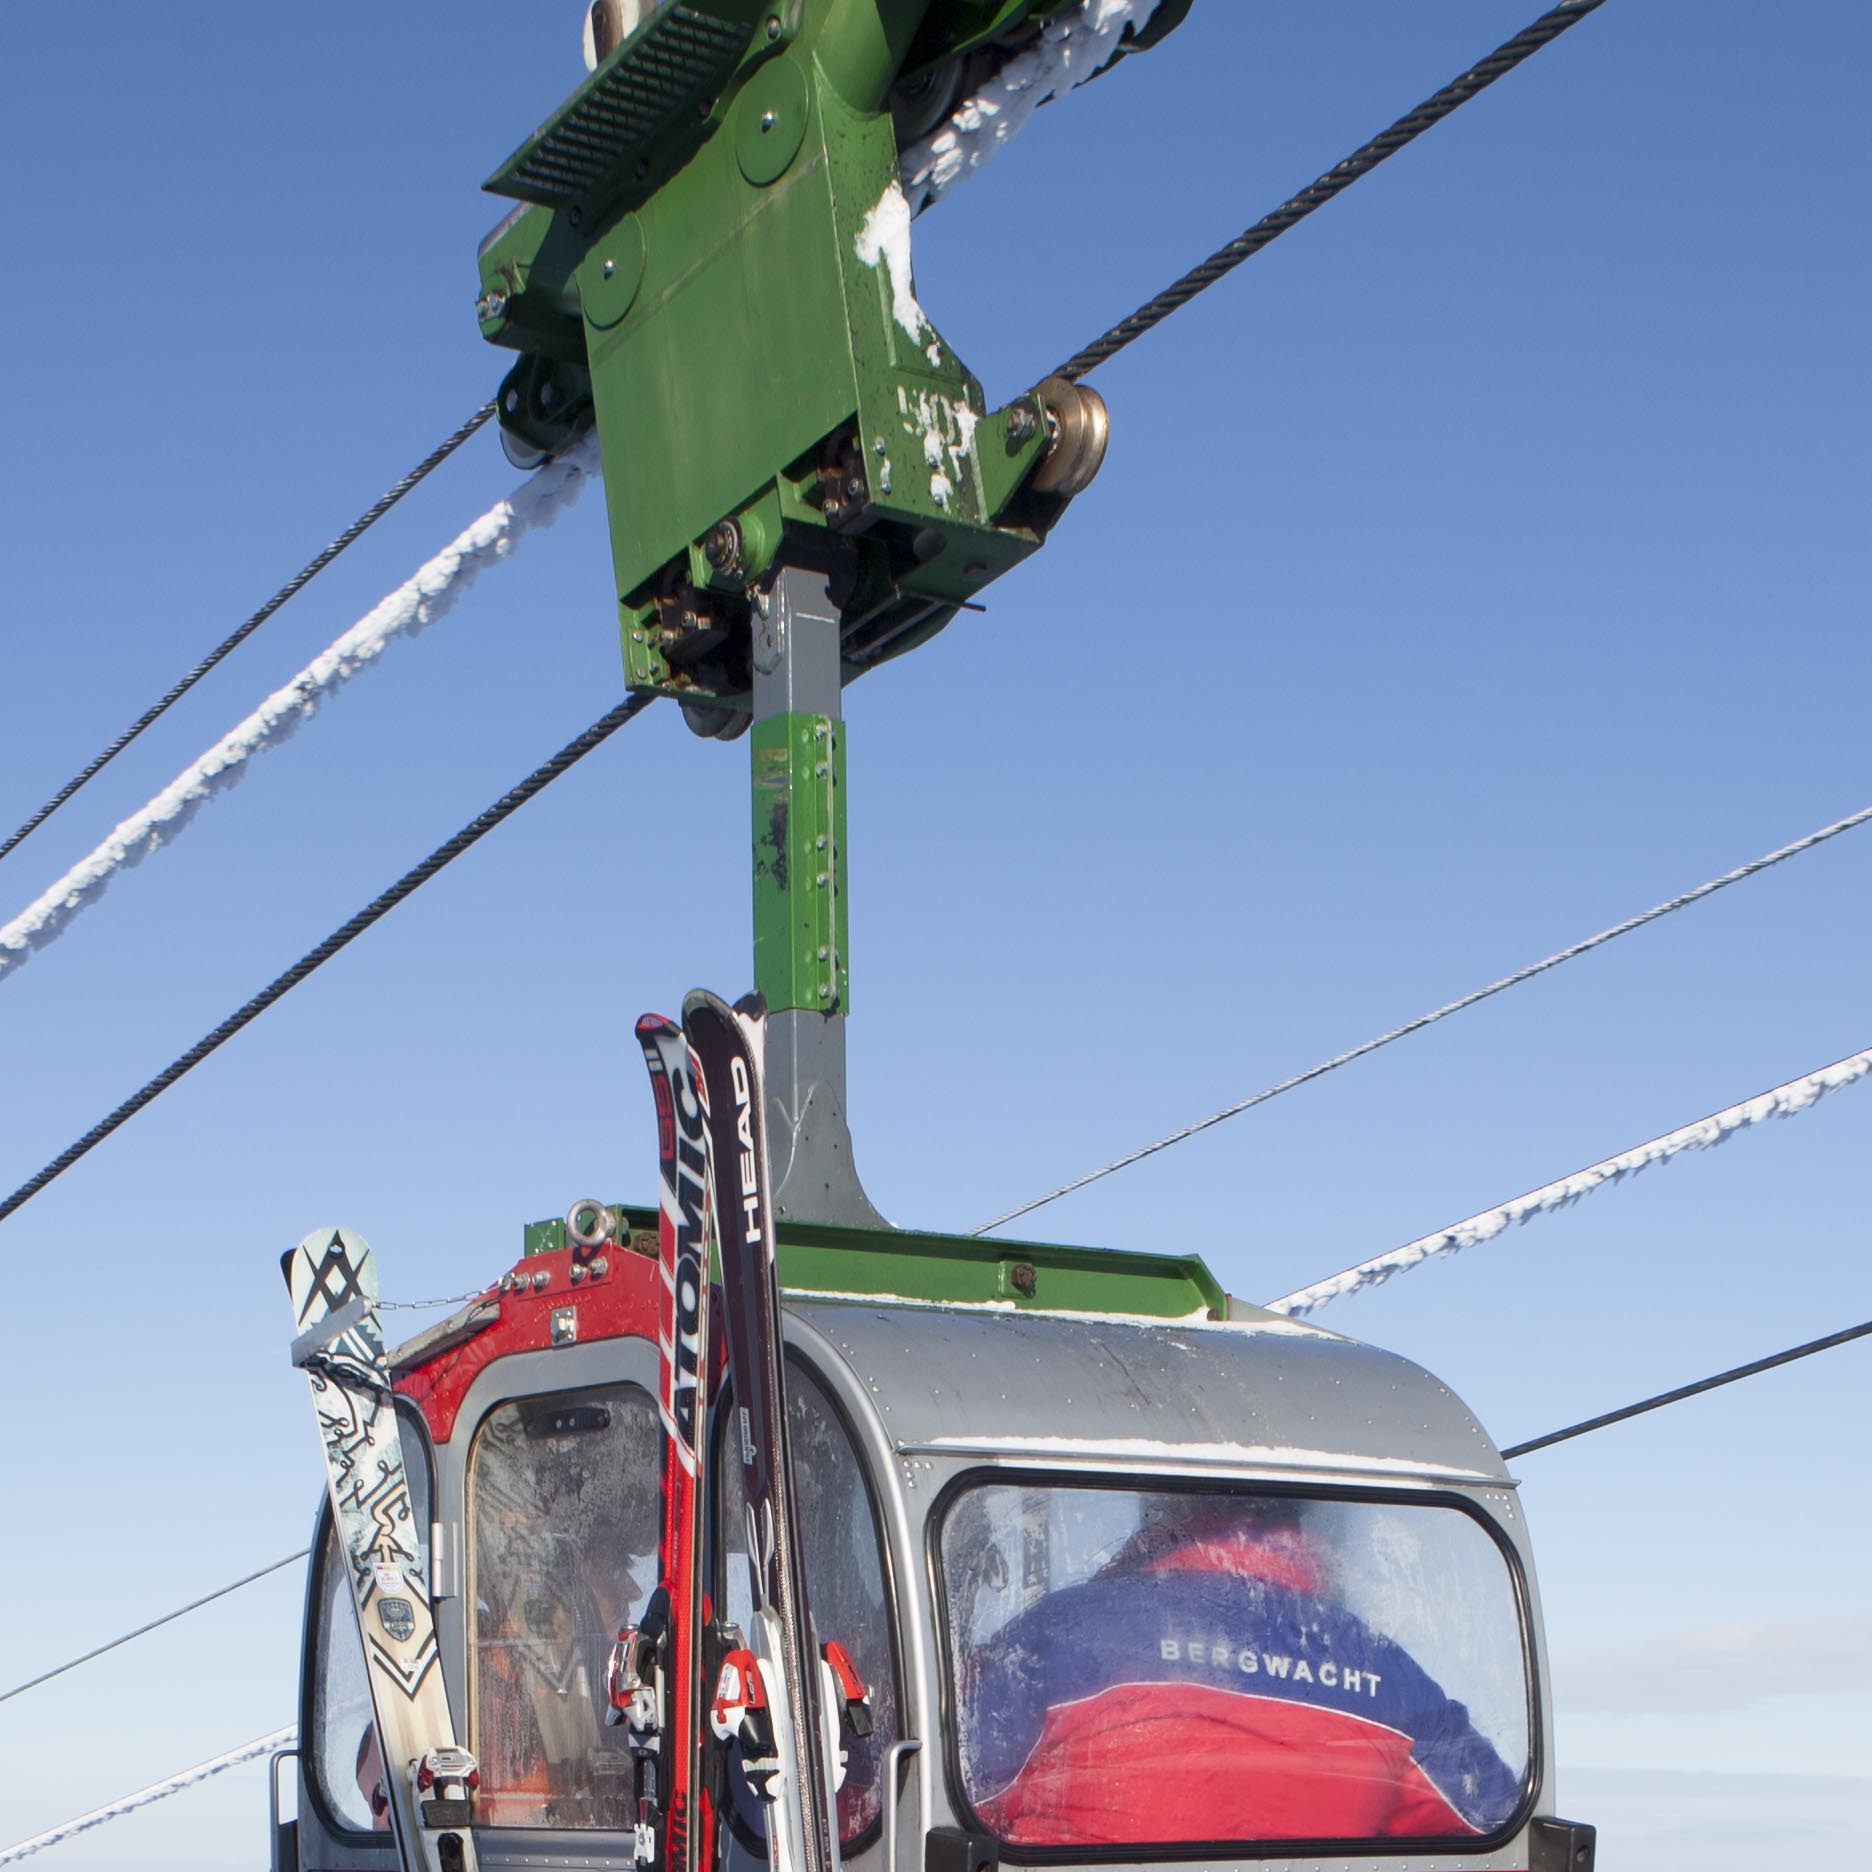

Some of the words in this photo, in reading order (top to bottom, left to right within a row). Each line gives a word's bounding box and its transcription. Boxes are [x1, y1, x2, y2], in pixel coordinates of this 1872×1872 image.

[731, 1056, 762, 1244] HEAD
[672, 1067, 707, 1452] ATOMIC
[1161, 1639, 1381, 1697] BERGWACHT
